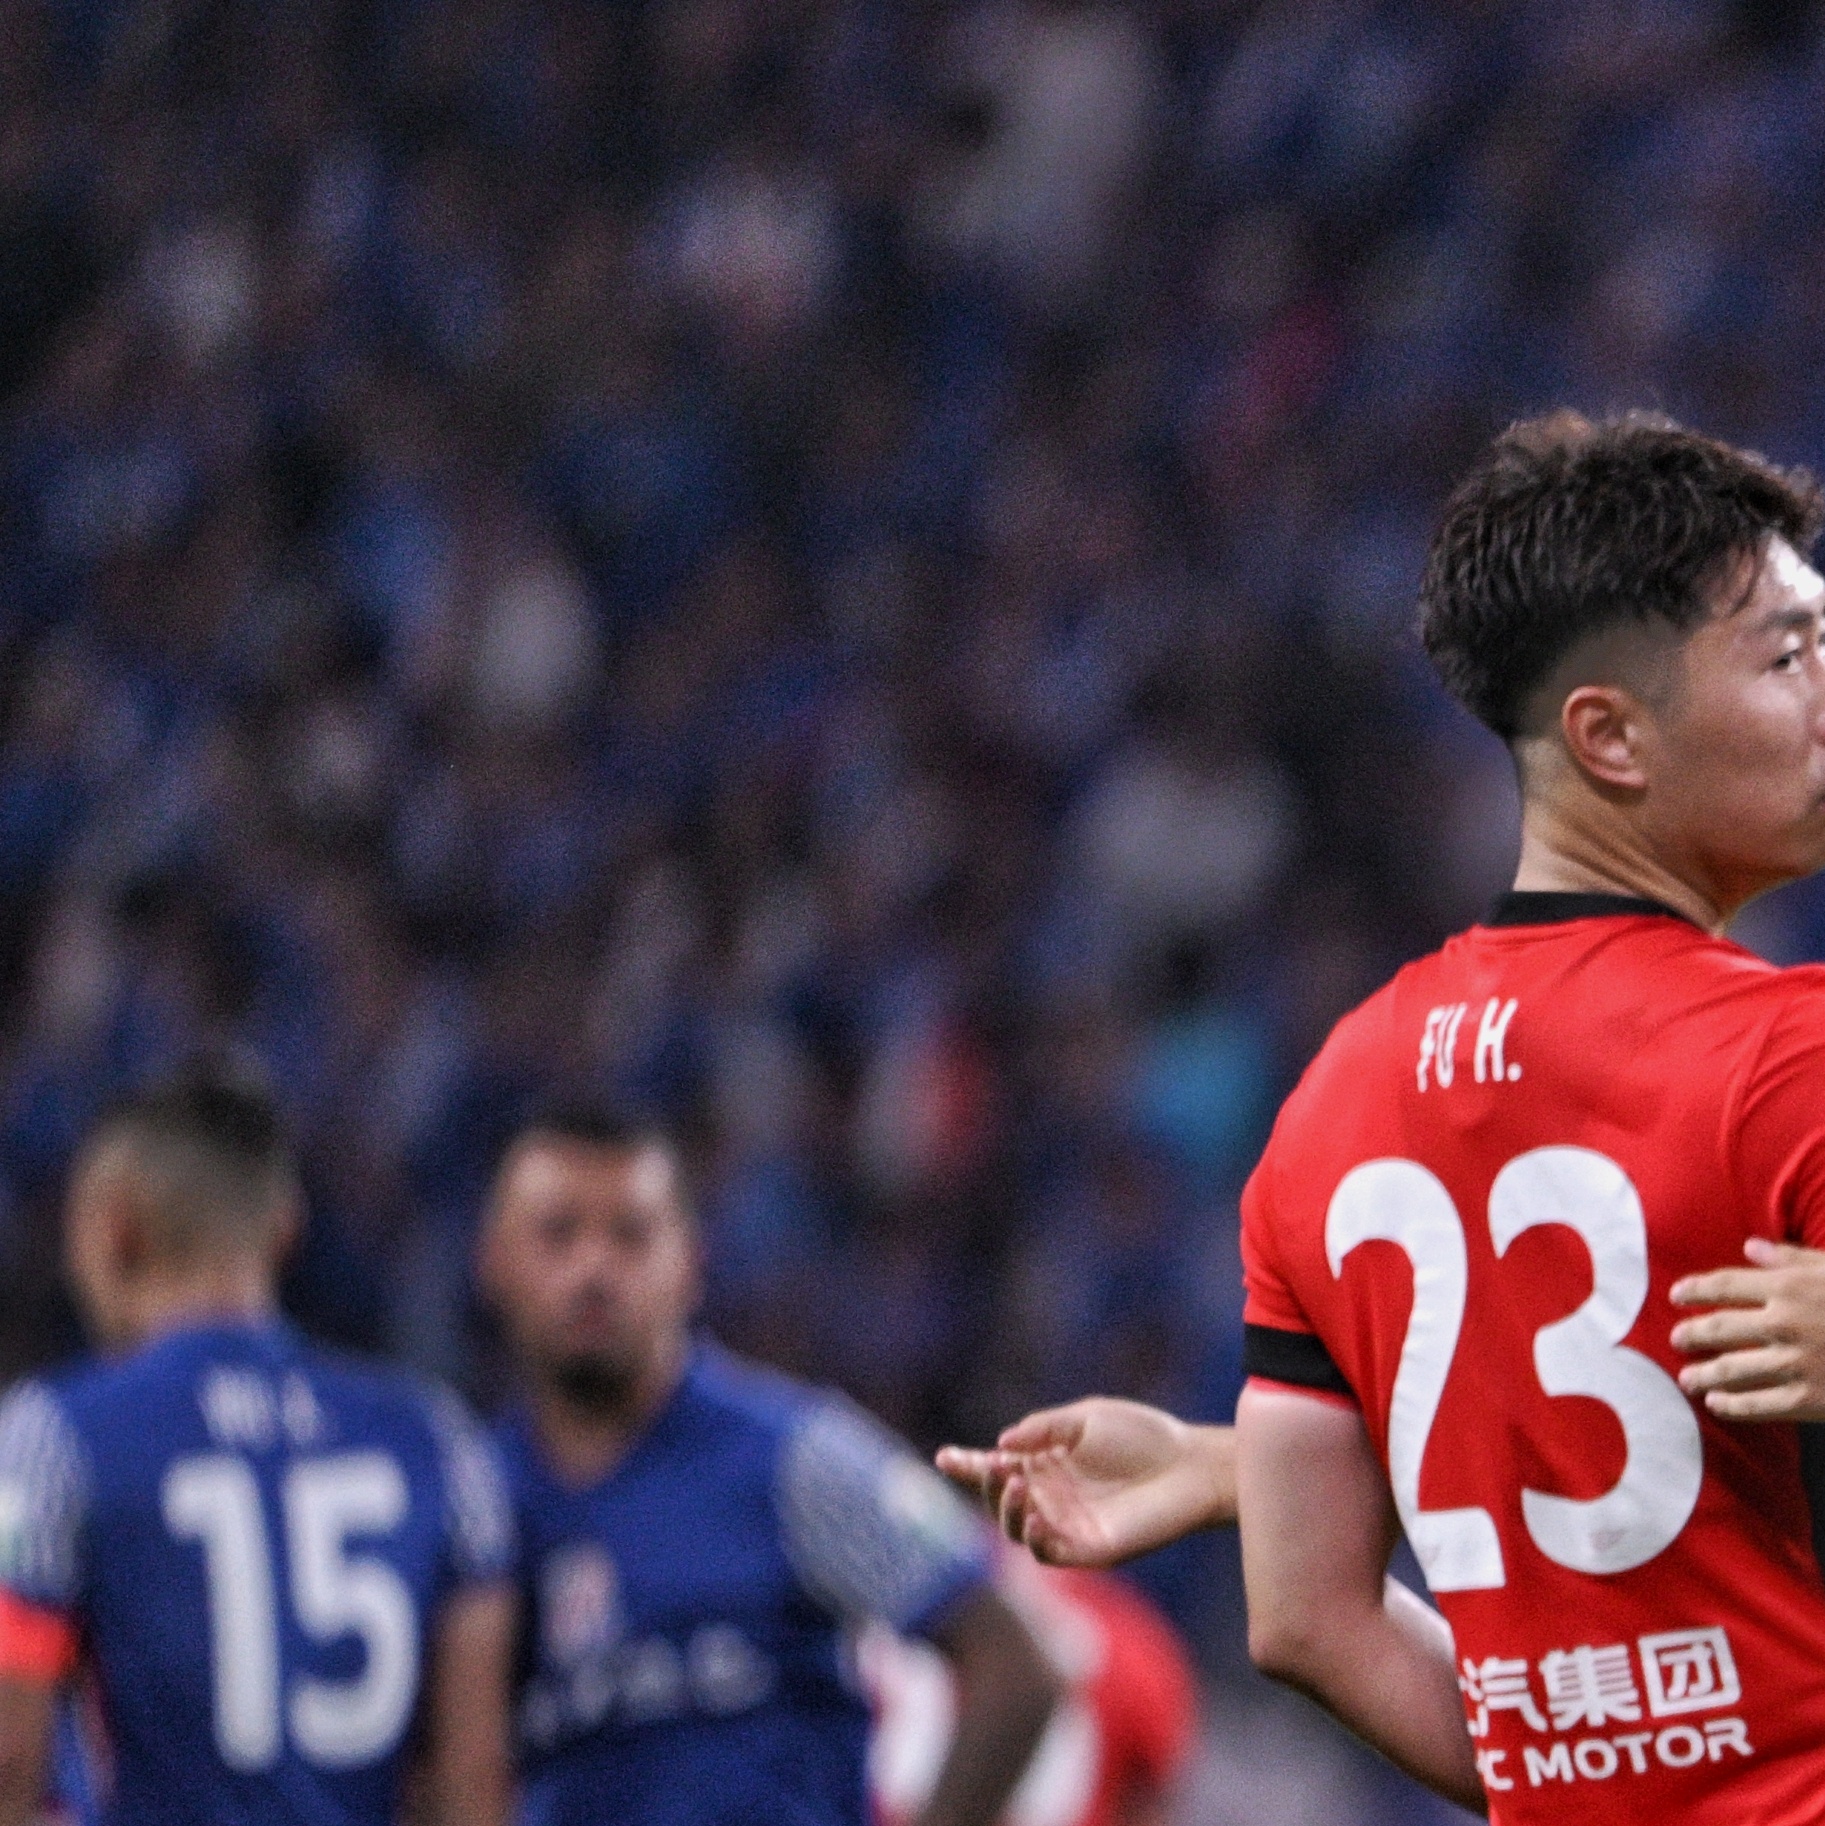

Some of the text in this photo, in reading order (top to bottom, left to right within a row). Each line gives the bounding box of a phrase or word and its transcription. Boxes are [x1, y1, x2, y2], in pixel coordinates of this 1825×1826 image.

[1416, 997, 1523, 1093] FU H.
[1325, 1145, 1704, 1592] 23
[161, 1448, 420, 1774] 15
[1459, 1625, 1742, 1737] 汽集团
[1523, 1717, 1755, 1788] MOTOR
